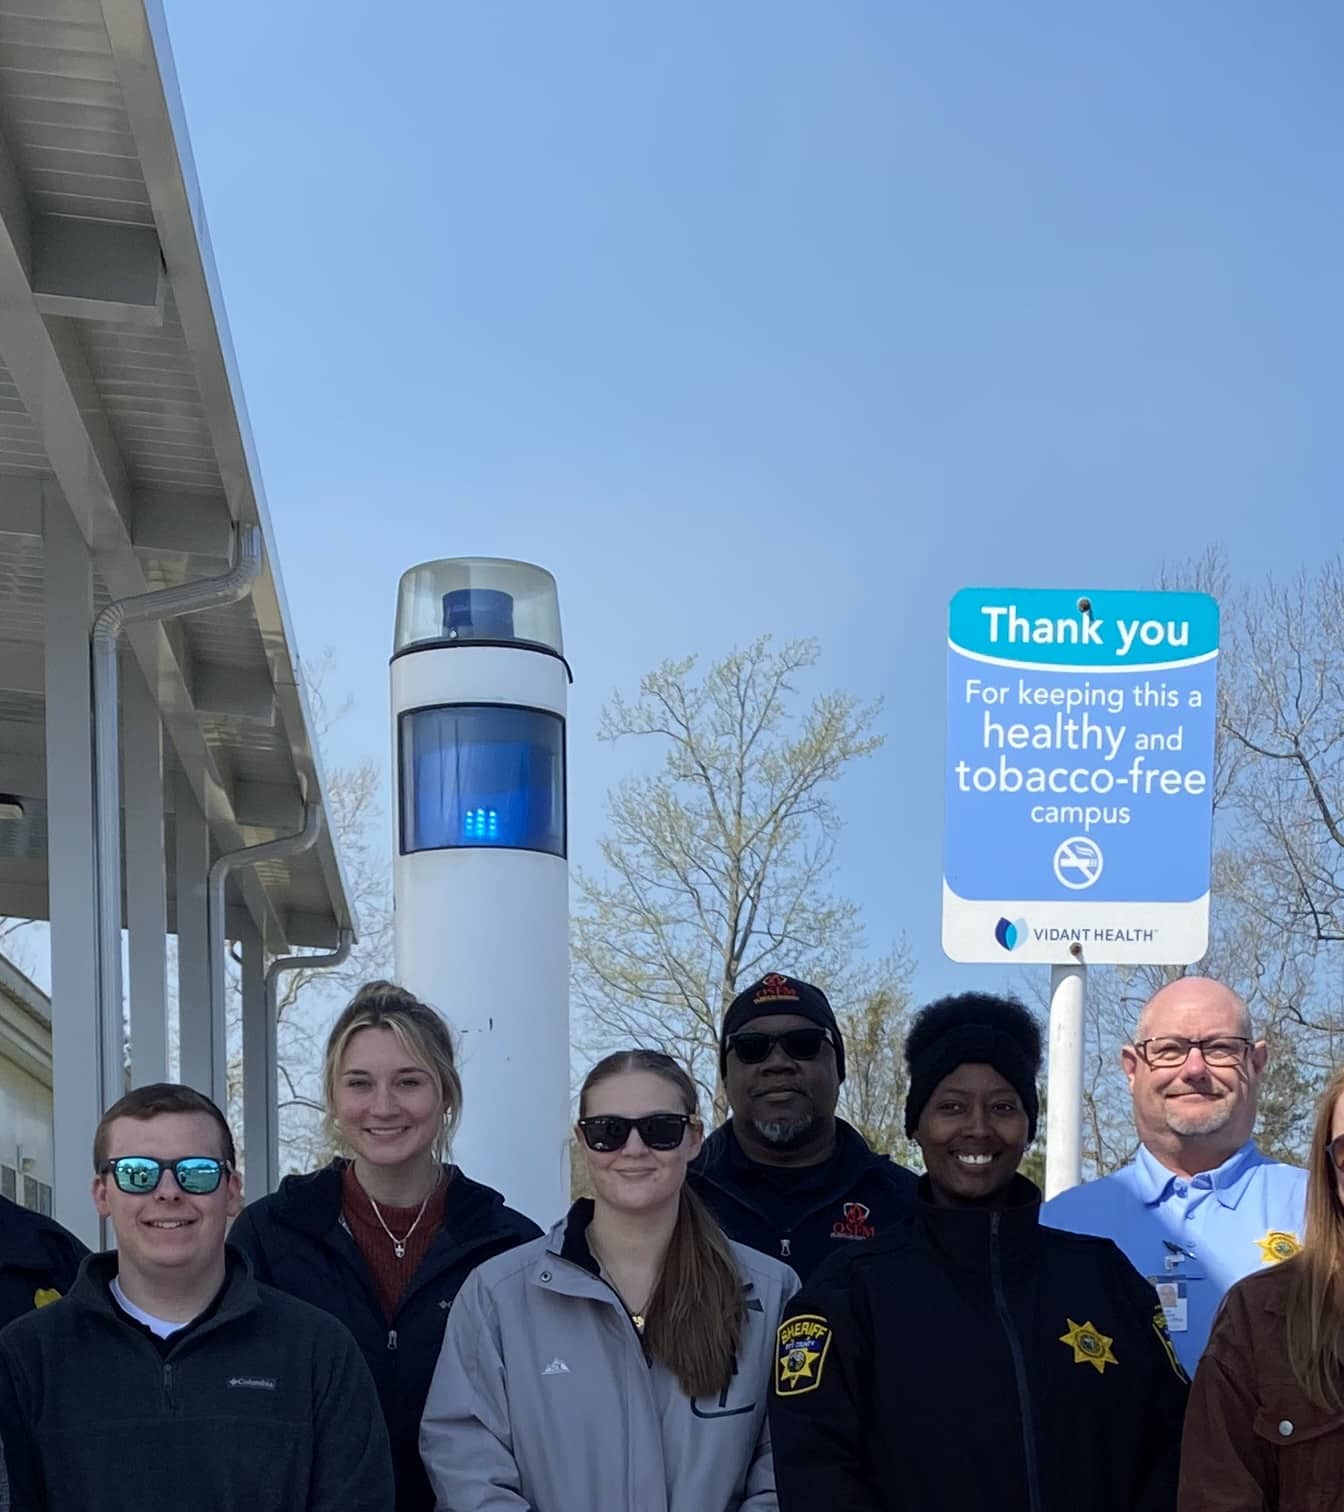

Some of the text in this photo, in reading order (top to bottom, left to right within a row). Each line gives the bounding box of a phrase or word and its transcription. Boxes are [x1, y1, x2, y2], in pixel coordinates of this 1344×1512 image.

[981, 604, 1189, 656] Thank you
[965, 679, 1203, 714] For keeping this a
[983, 710, 1184, 761] healthy and
[954, 754, 1207, 795] tobacco-free
[1030, 805, 1132, 833] campus
[1033, 928, 1154, 943] VIDANT HEALTH
[780, 1321, 828, 1345] SHERIFF
